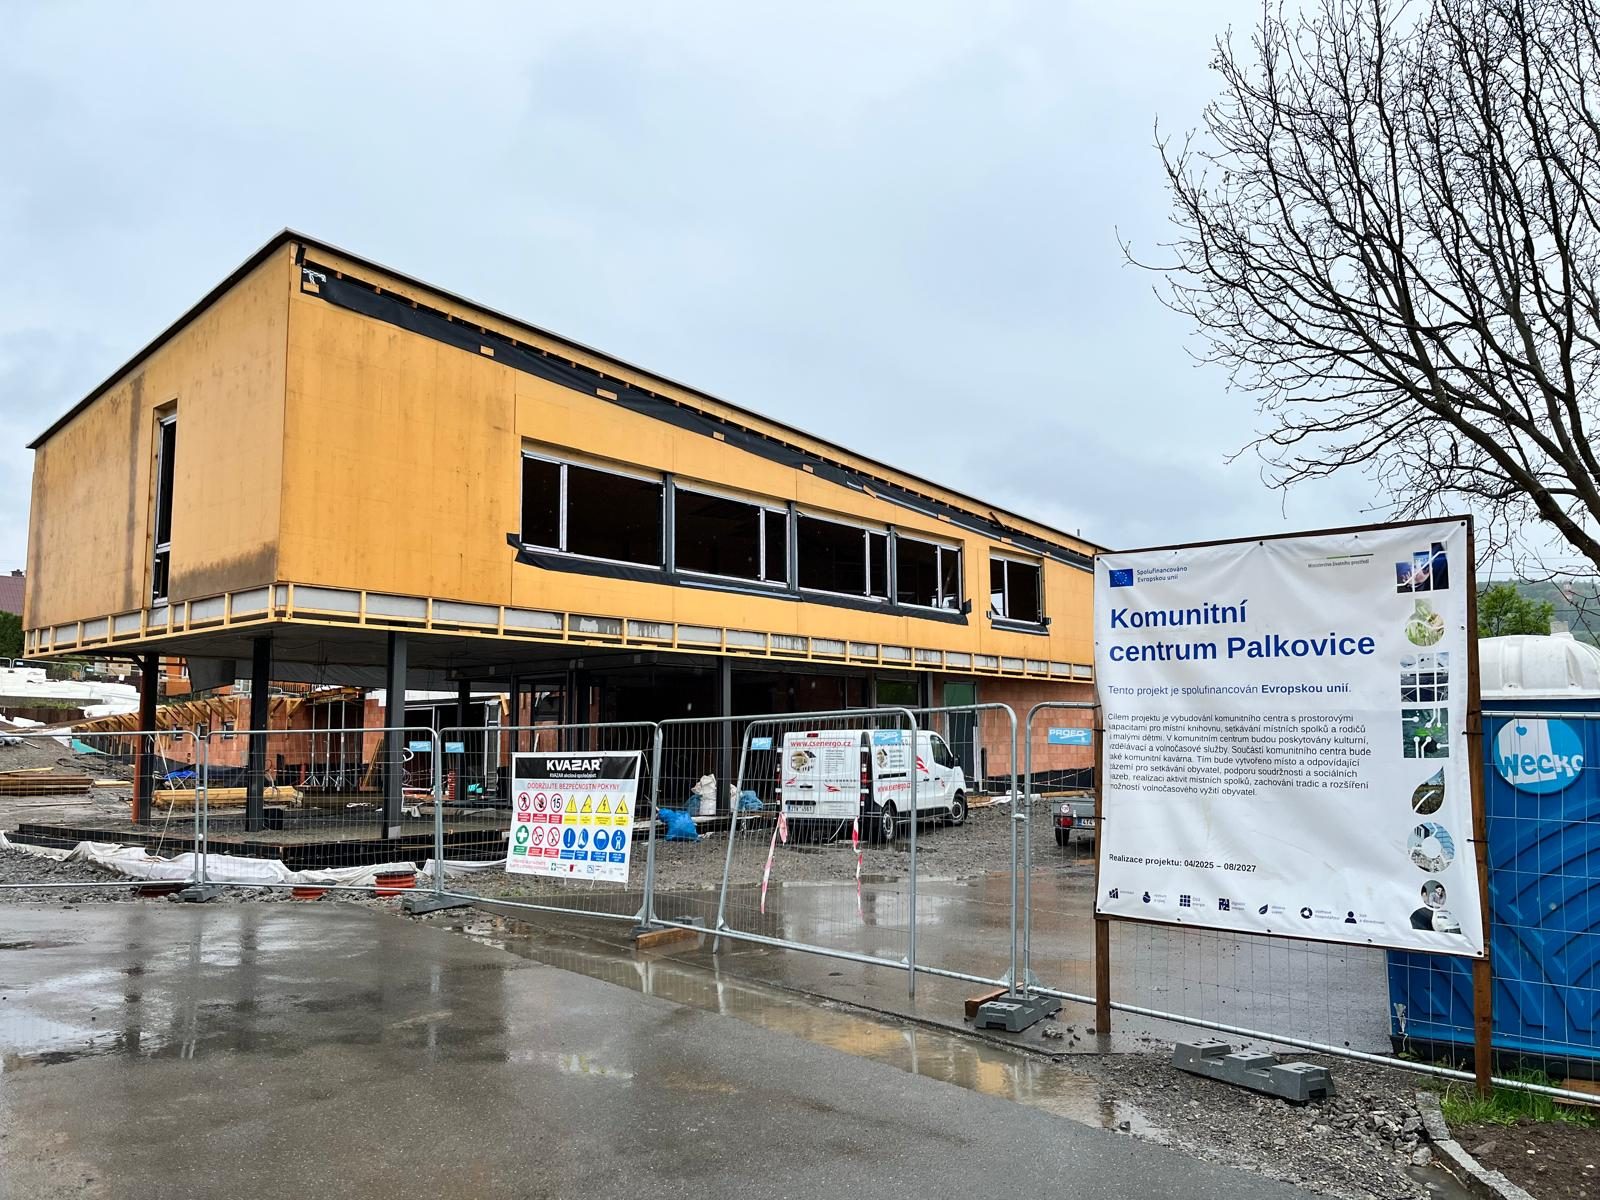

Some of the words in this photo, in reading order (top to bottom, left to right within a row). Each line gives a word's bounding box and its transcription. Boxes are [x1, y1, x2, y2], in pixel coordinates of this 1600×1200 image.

[1136, 566, 1188, 575] Spolufinancováno
[1137, 575, 1166, 583] Evropskou
[1110, 599, 1247, 629] Komunitní
[1109, 640, 1218, 662] centrum
[1227, 632, 1375, 659] Palkovice
[1108, 685, 1134, 695] Tento
[1137, 686, 1168, 696] projekt
[1170, 686, 1179, 696] je
[1182, 685, 1258, 696] spolufinancován
[1261, 684, 1323, 695] Evropskou
[1327, 683, 1351, 693] unií.
[1131, 713, 1161, 723] projektu
[1162, 714, 1168, 723] je
[1170, 714, 1213, 723] vybudování
[1214, 714, 1261, 722] komunitního
[1298, 714, 1354, 723] prostorovými
[1149, 725, 1161, 733] pro
[1162, 724, 1186, 732] místní
[1187, 725, 1223, 733] knihovnu,
[1224, 725, 1261, 733] setkávání
[1263, 725, 1298, 733] místních
[1300, 724, 1329, 734] spolků
[1339, 724, 1366, 733] rodičů
[790, 740, 851, 749] www.csenergo.cz
[1113, 733, 1140, 741] malými
[1174, 734, 1217, 742] komunitním
[1278, 736, 1331, 745] poskytovány
[1334, 736, 1369, 745] kulturní,
[1156, 744, 1201, 753] volnočasové
[1203, 745, 1229, 754] služby.
[1231, 745, 1264, 754] Součástí
[1266, 746, 1317, 755] komunitního
[1320, 748, 1346, 756] centra
[1349, 747, 1371, 756] bude
[546, 759, 601, 771] KVAZAR
[1109, 753, 1122, 761] aké
[1124, 754, 1161, 762] komunitní
[1197, 755, 1211, 763] Tím
[1214, 756, 1234, 764] bude
[1235, 757, 1272, 765] vytvořeno
[1274, 757, 1297, 766] místo
[1307, 758, 1360, 768] odpovídající
[1135, 765, 1148, 773] pro
[1150, 765, 1186, 773] setkávání
[1187, 766, 1222, 774] obyvatel,
[1223, 767, 1256, 776] podporu
[1258, 768, 1303, 776] soudržnosti
[1313, 768, 1358, 778] sociálních
[1133, 774, 1164, 782] realizaci
[1166, 775, 1188, 783] aktivit
[1190, 776, 1222, 784] místních
[1224, 777, 1252, 786] spolků,
[1254, 778, 1294, 787] zachování
[1296, 780, 1319, 788] tradic
[1330, 780, 1369, 789] rozšíření
[1142, 784, 1198, 794] volnočasového
[1199, 786, 1219, 795] vyžití
[1222, 788, 1256, 797] obyvatel.
[553, 798, 561, 809] 15
[1109, 853, 1143, 864] Realizace
[1145, 857, 1182, 867] projektu:
[1184, 860, 1214, 869] 04/2025
[1223, 862, 1256, 873] 08/2027
